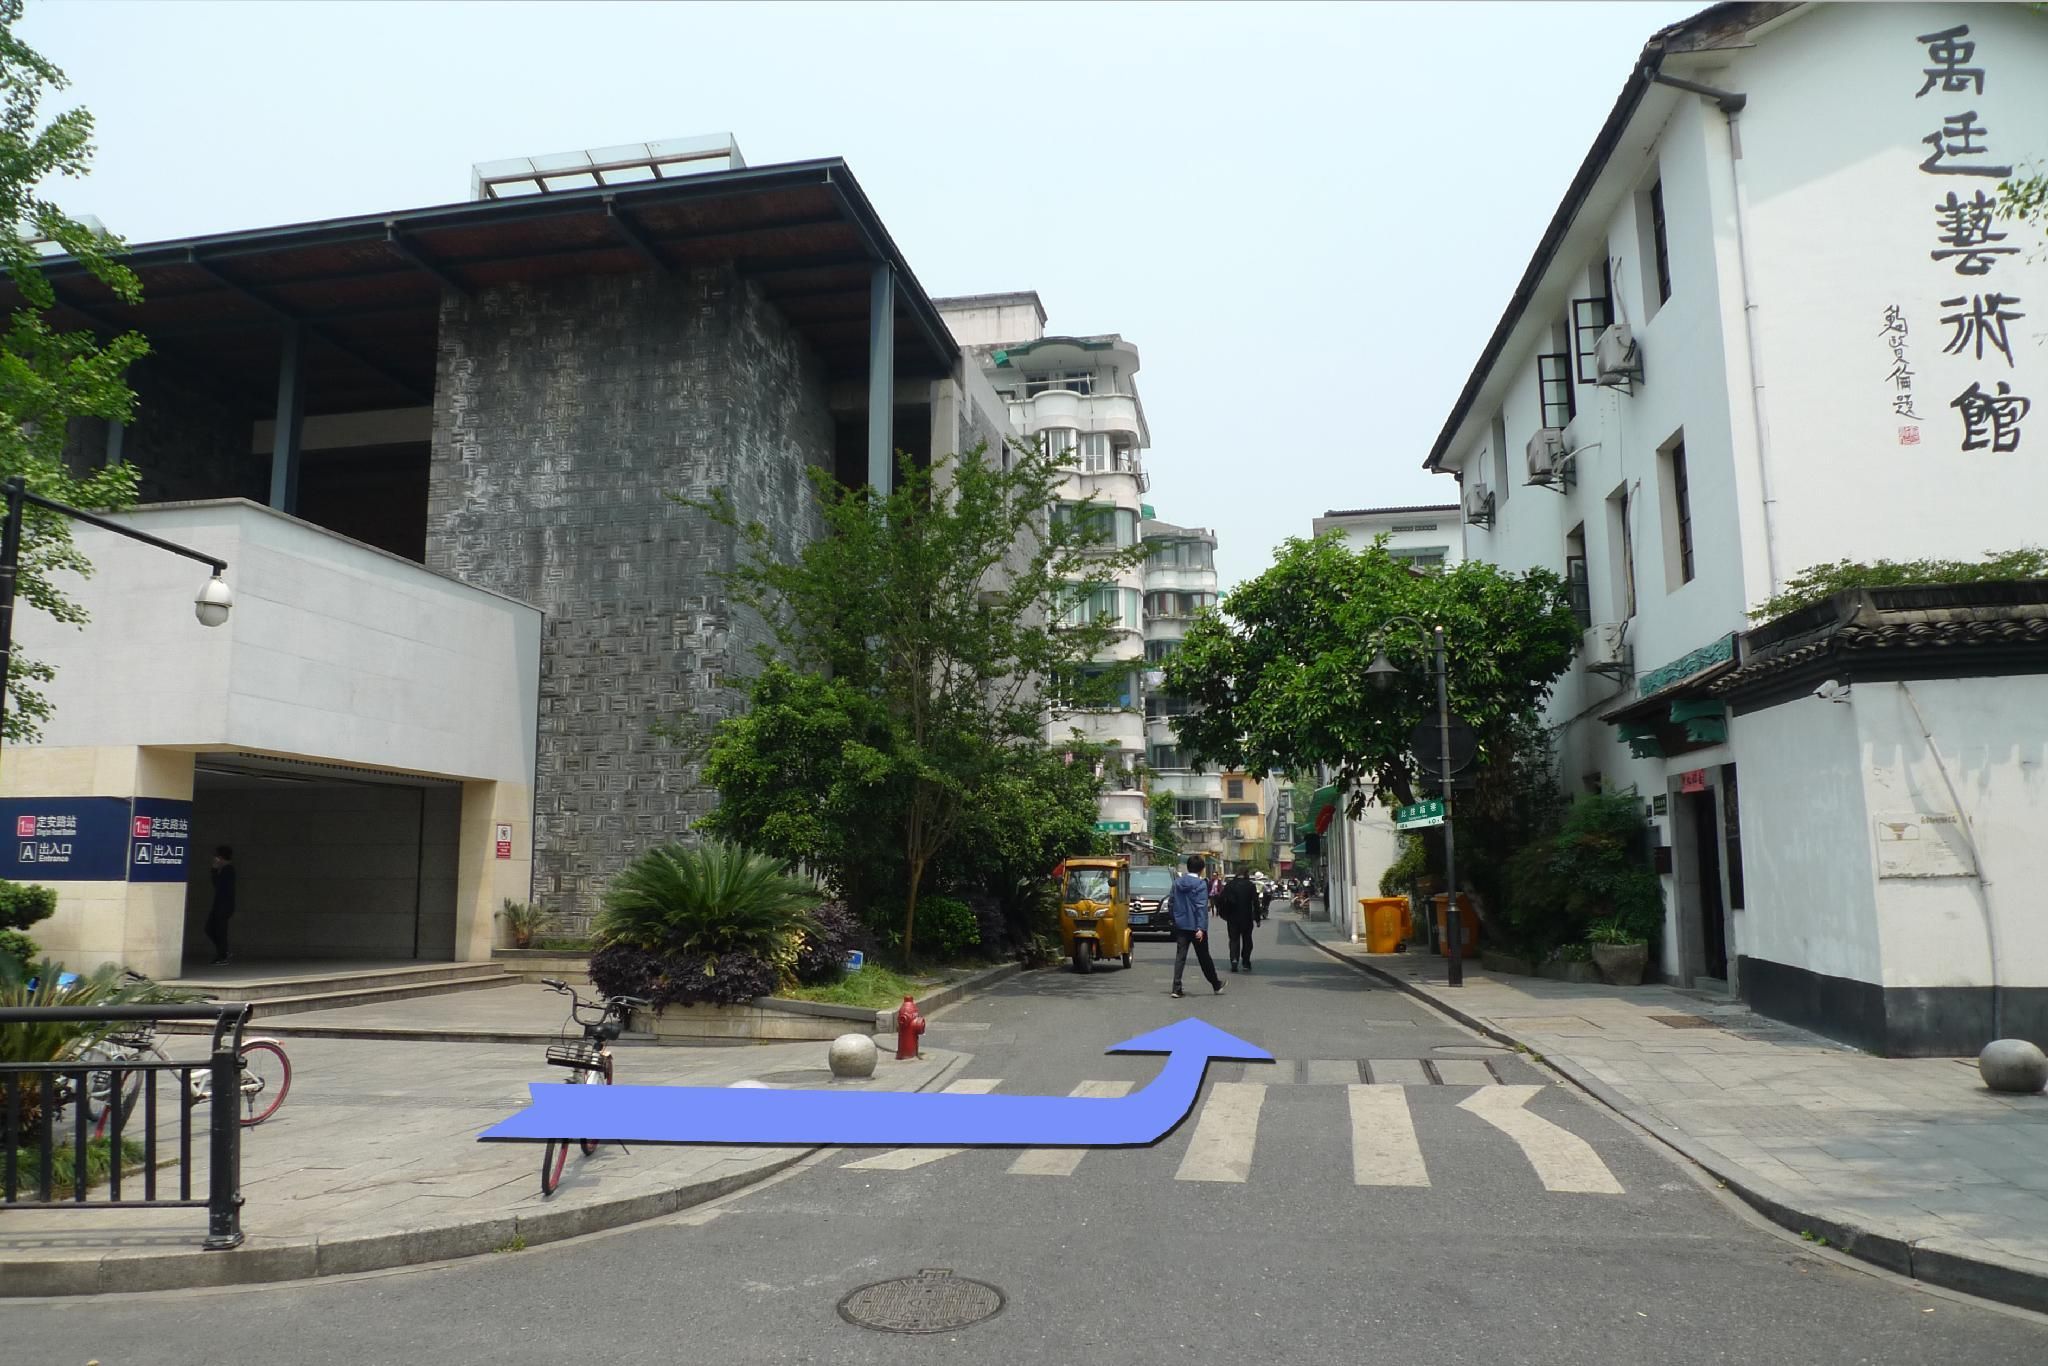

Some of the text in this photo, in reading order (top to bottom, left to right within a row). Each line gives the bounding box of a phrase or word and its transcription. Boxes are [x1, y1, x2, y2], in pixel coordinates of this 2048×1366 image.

[36, 815, 77, 828] 定安路站
[151, 817, 188, 830] 定安路站
[22, 842, 72, 860] A 出入口
[137, 844, 184, 861] A 出入口
[38, 854, 70, 862] Entrance
[153, 856, 182, 864] Entrance
